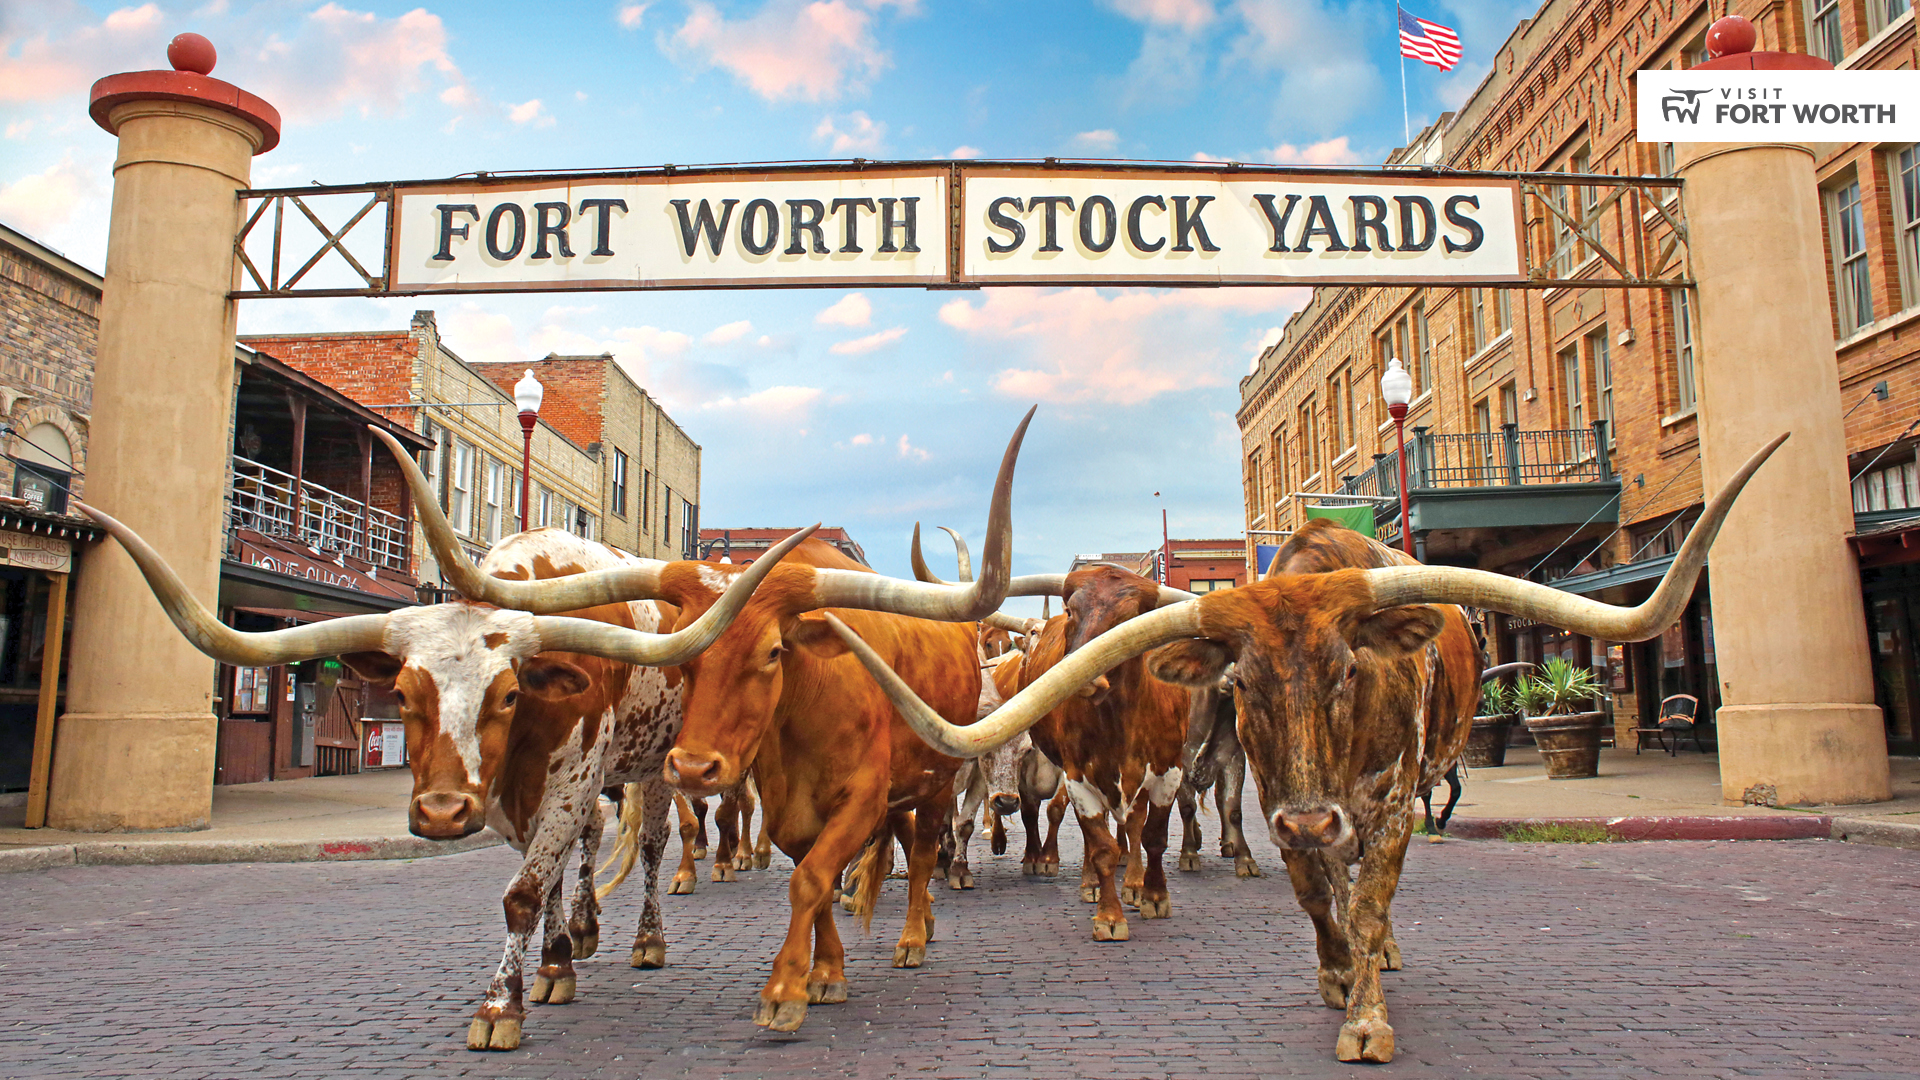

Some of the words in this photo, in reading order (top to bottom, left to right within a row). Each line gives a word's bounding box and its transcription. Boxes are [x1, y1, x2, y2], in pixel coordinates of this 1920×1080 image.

[432, 198, 628, 262] FORT
[669, 196, 922, 258] WORTH
[986, 194, 1222, 255] STOCK
[1252, 193, 1486, 254] YARDS
[23, 492, 44, 502] COFFEE
[20, 536, 32, 548] OF
[35, 539, 67, 554] BLADES
[14, 550, 36, 564] KNIFE
[37, 554, 60, 566] ALLEY
